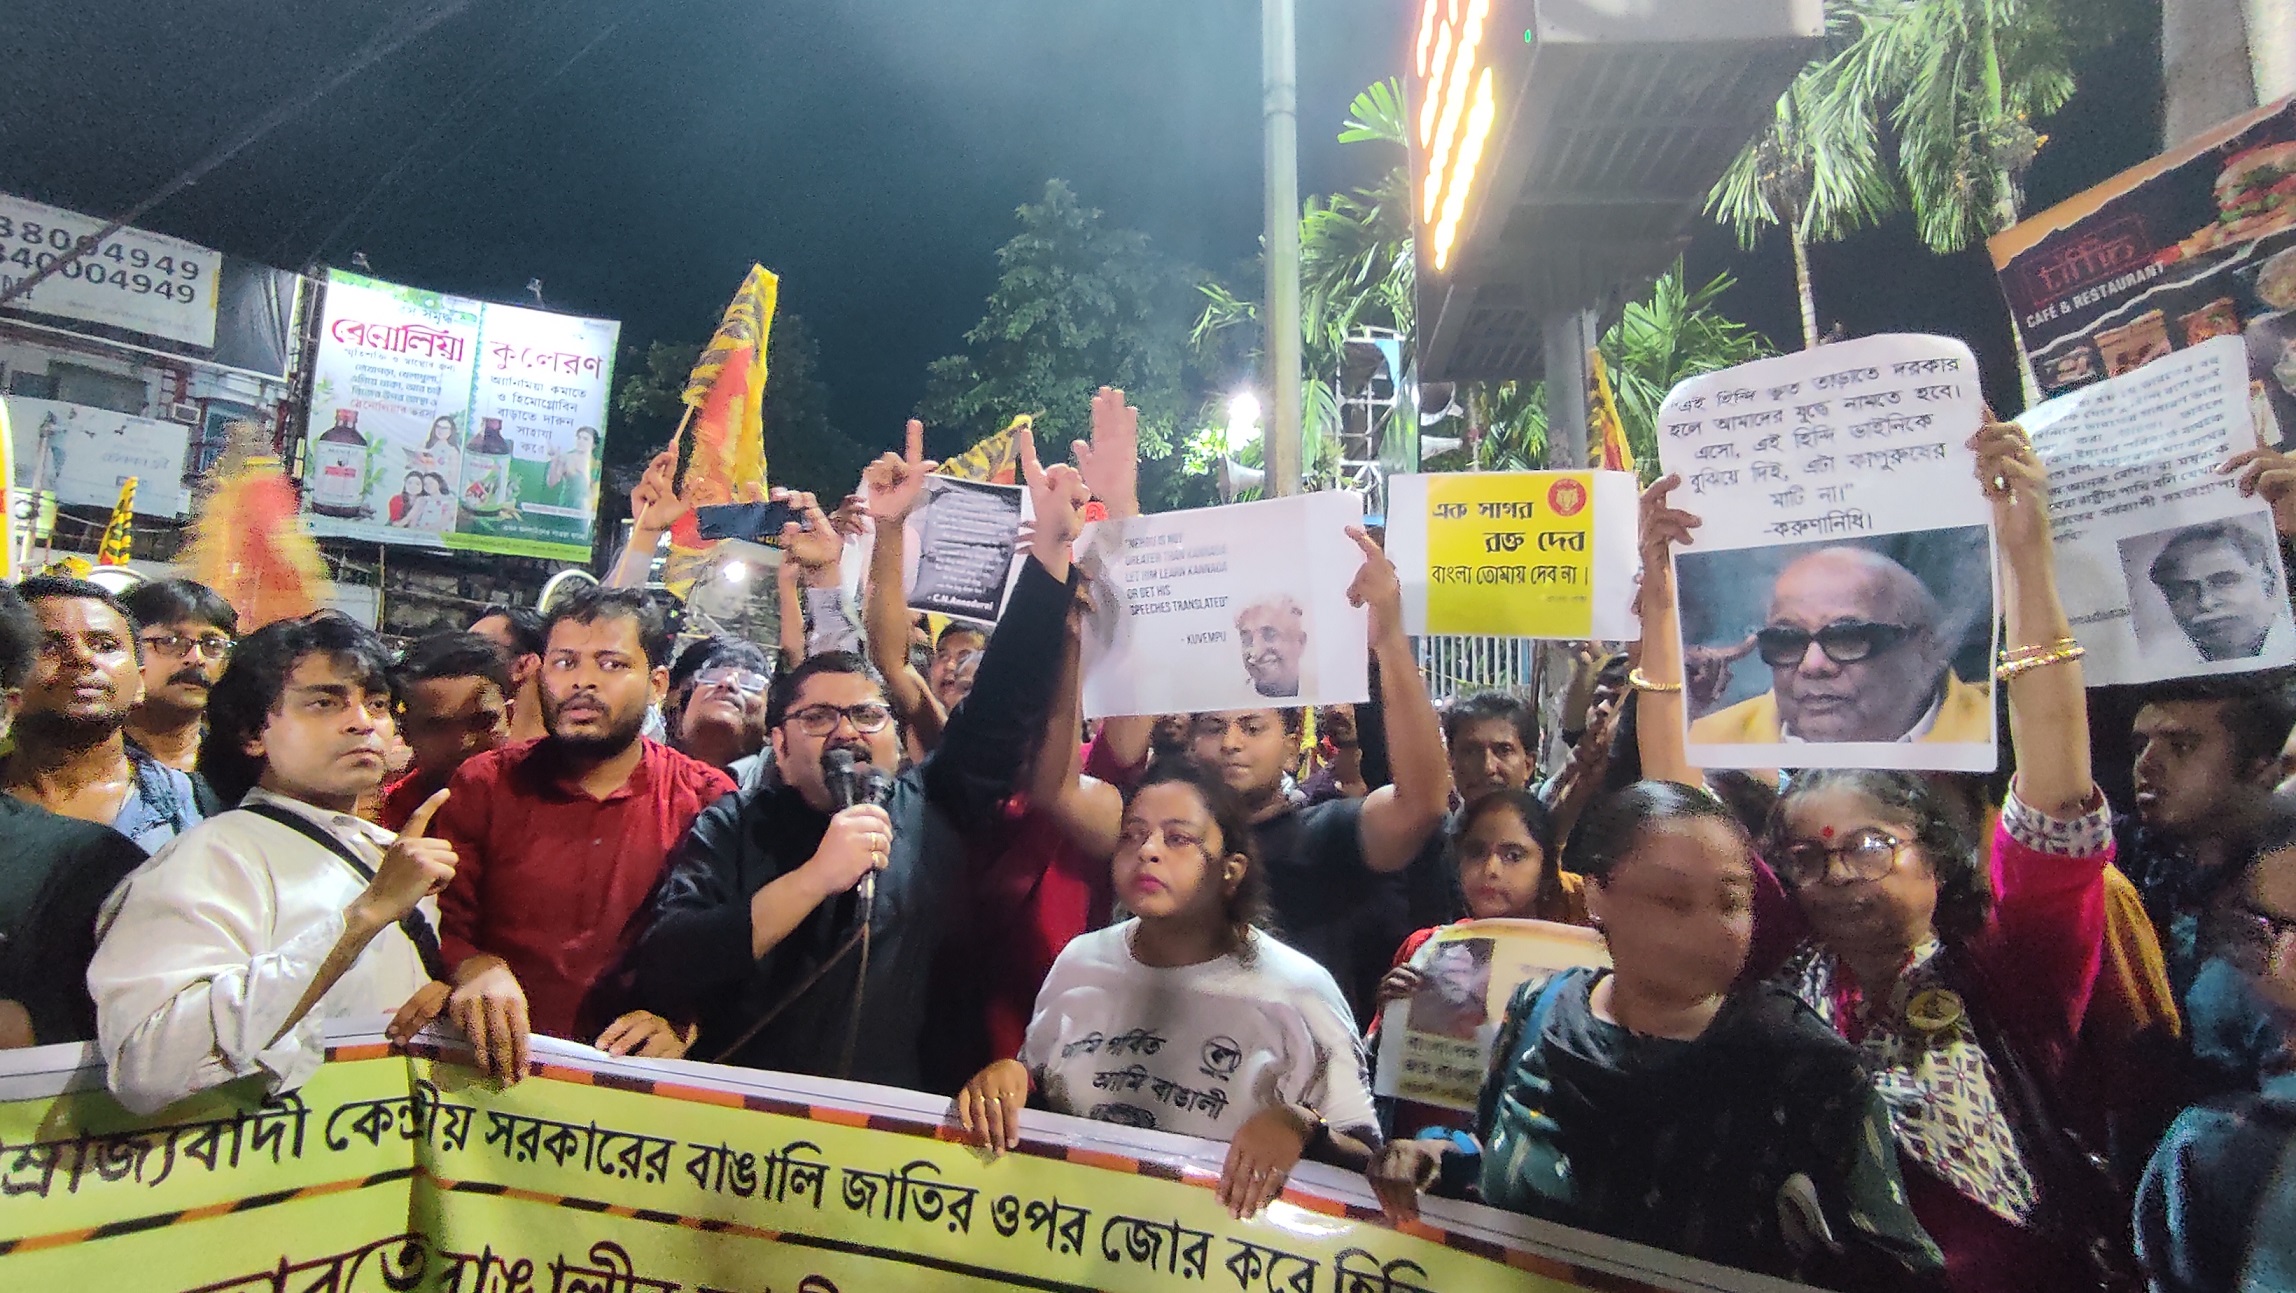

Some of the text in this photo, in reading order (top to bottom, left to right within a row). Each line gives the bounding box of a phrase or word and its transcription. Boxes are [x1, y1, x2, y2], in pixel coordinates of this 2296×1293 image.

[2060, 301, 2072, 313] &
[2072, 260, 2164, 309] RESTAURANT
[1812, 366, 1880, 390] তাড়াতে
[1890, 357, 1961, 376] দরকার
[1667, 421, 1703, 438] হলে
[1713, 409, 1784, 431] আমাদের
[1843, 390, 1904, 409] নামতে
[1914, 384, 1961, 401] হবে।
[1695, 443, 1740, 459] এসো,
[1753, 433, 1783, 451] এই
[1793, 425, 1835, 448] হিন্দি
[1432, 502, 1534, 520] এক সাগর
[1483, 531, 1585, 553] রক্ত দেব
[1431, 566, 1472, 585] বাংলা
[1476, 565, 1527, 585] তোমায়
[1530, 565, 1557, 585] দেব
[1127, 588, 1138, 600] OR
[1156, 584, 1171, 597] HIS
[1130, 601, 1171, 615] SPEECHES
[1092, 1064, 1150, 1095] আমি
[485, 1109, 678, 1184] সরকারের
[686, 1140, 831, 1210] বাঙালি
[842, 1160, 980, 1235] জাতির
[991, 1194, 1091, 1256] ওপর
[1101, 1214, 1215, 1281] জোর
